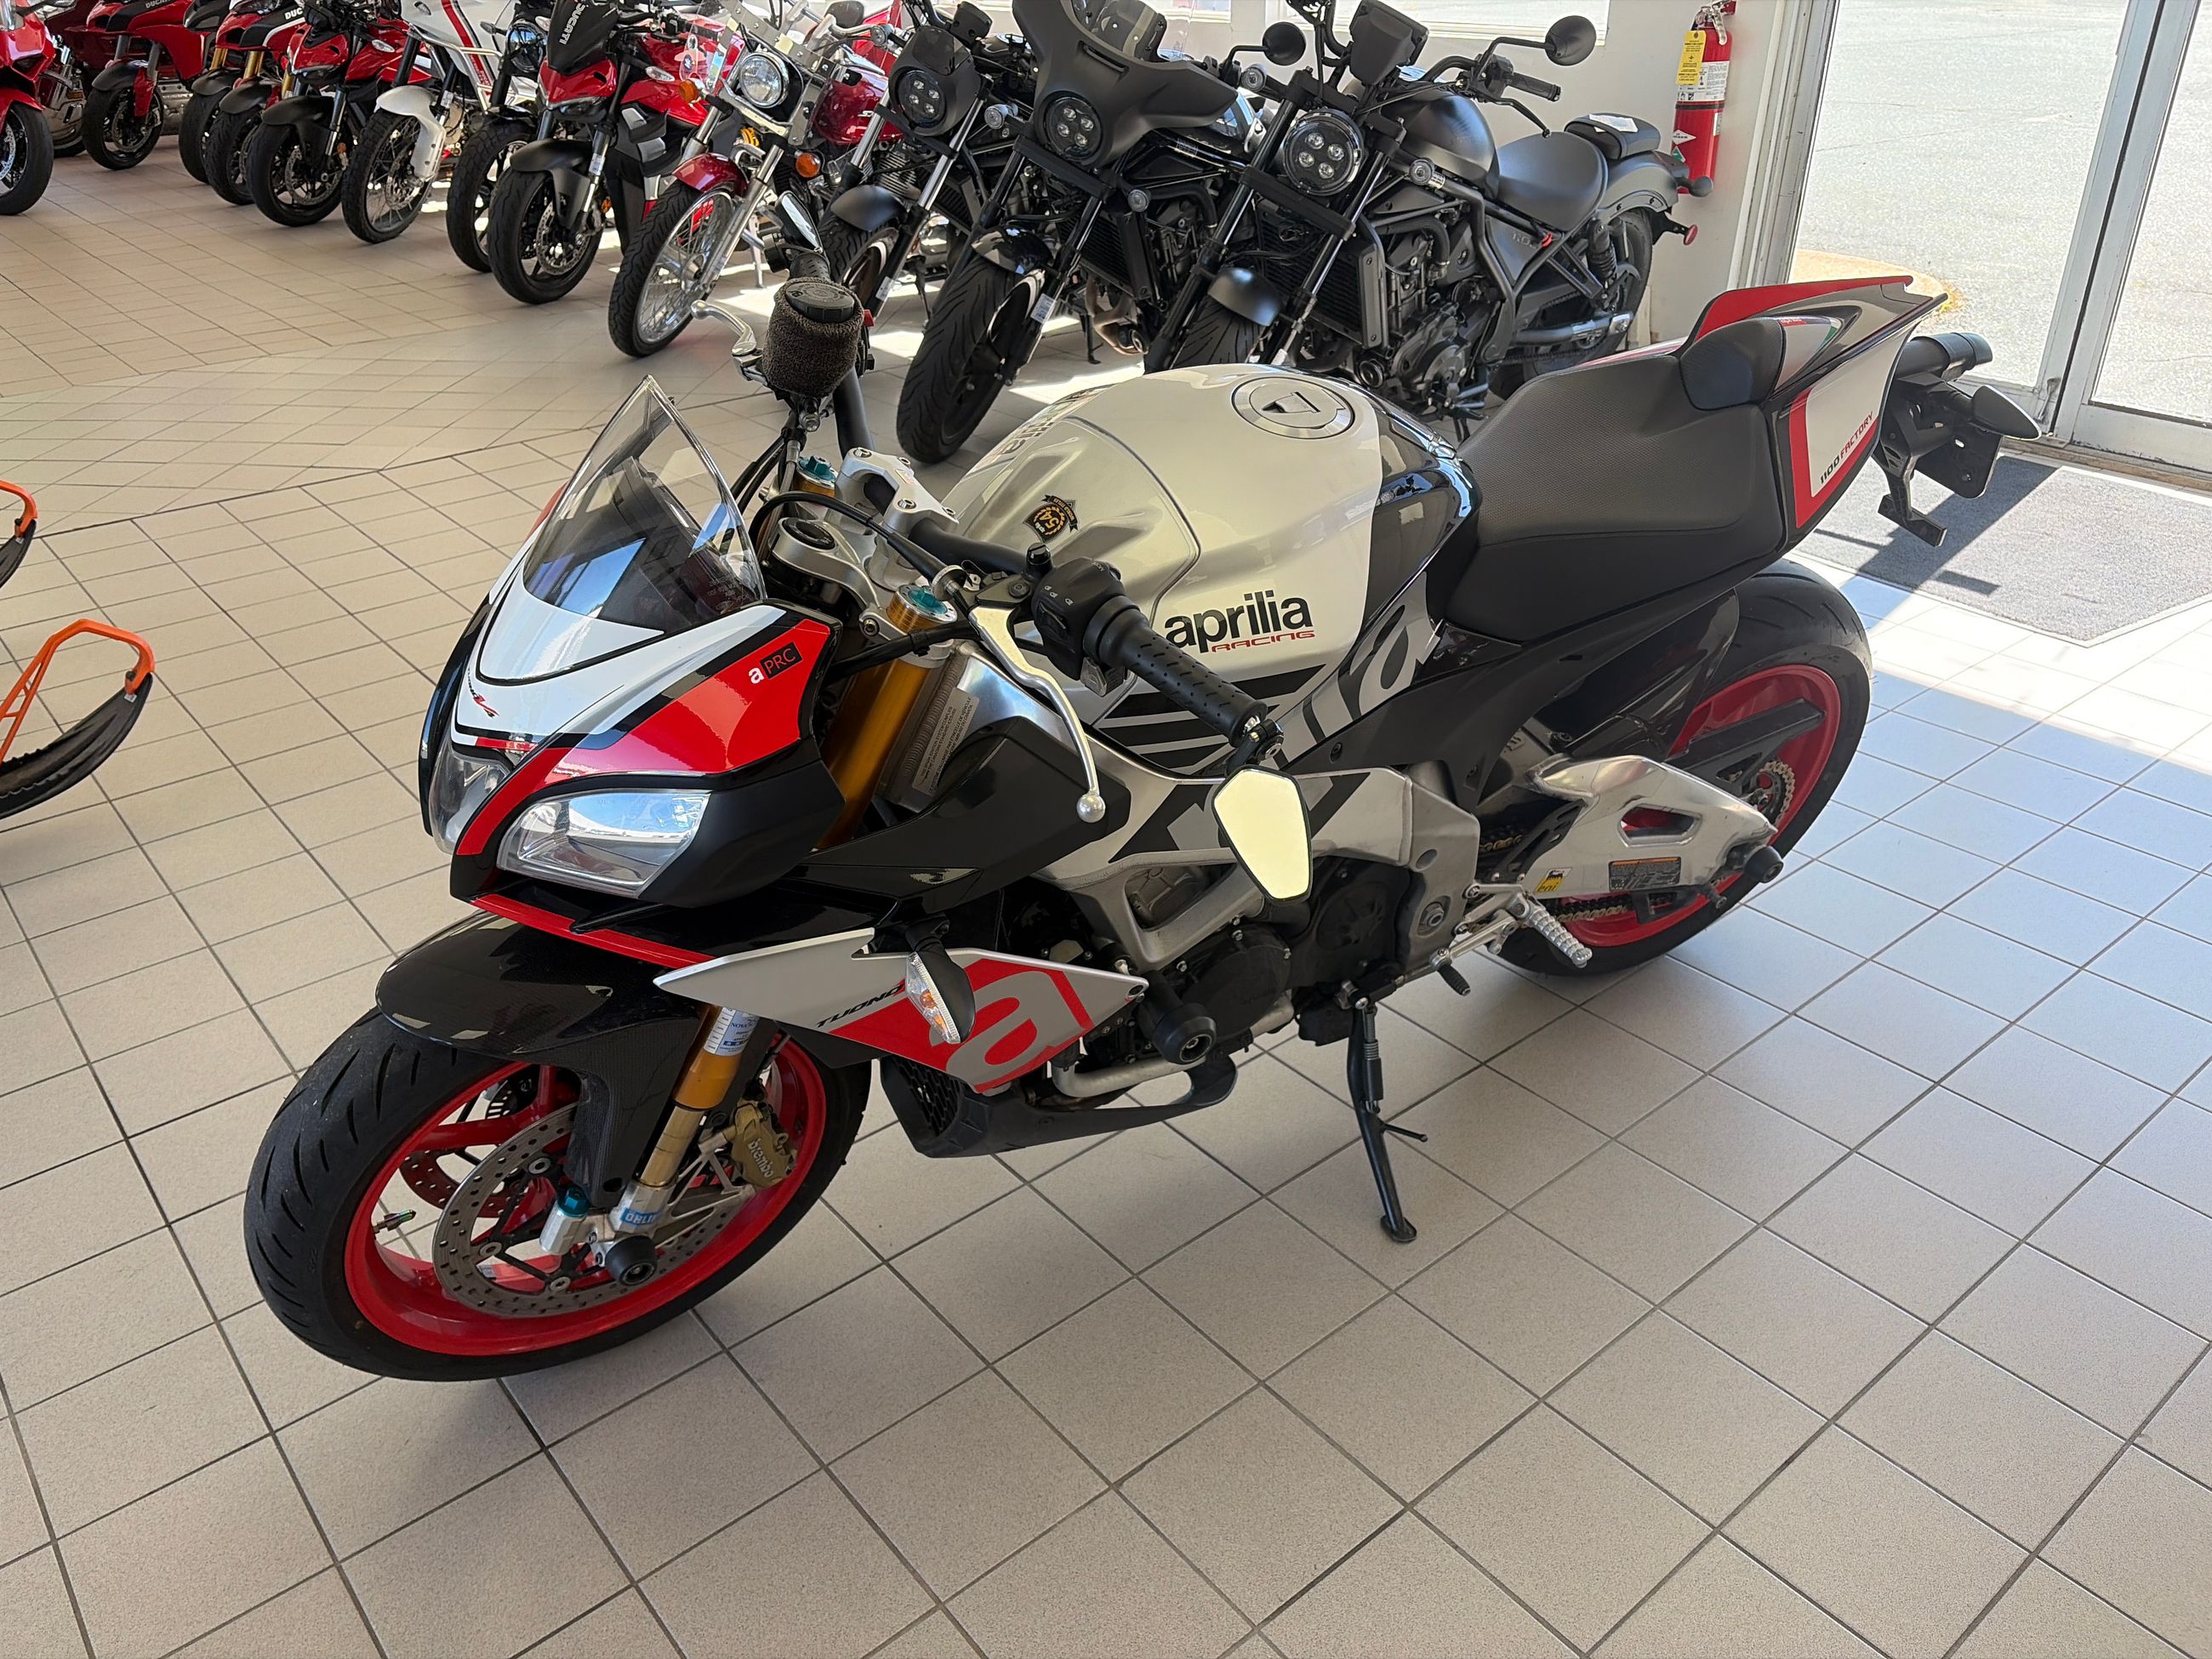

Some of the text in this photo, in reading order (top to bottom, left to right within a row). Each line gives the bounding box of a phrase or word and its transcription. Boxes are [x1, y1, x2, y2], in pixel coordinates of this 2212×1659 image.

[284, 8, 304, 20] DUC
[559, 3, 586, 44] DUCATI
[1820, 411, 1873, 484] 1100 FACTORY
[1040, 510, 1059, 528] 54
[1164, 590, 1314, 653] aprilia
[1211, 630, 1315, 653] RACING
[764, 648, 796, 675] PRC
[1536, 881, 1559, 892] eni
[816, 983, 905, 1029] TUONO
[748, 1138, 774, 1178] brembo
[624, 1210, 656, 1224] ÖHLI
